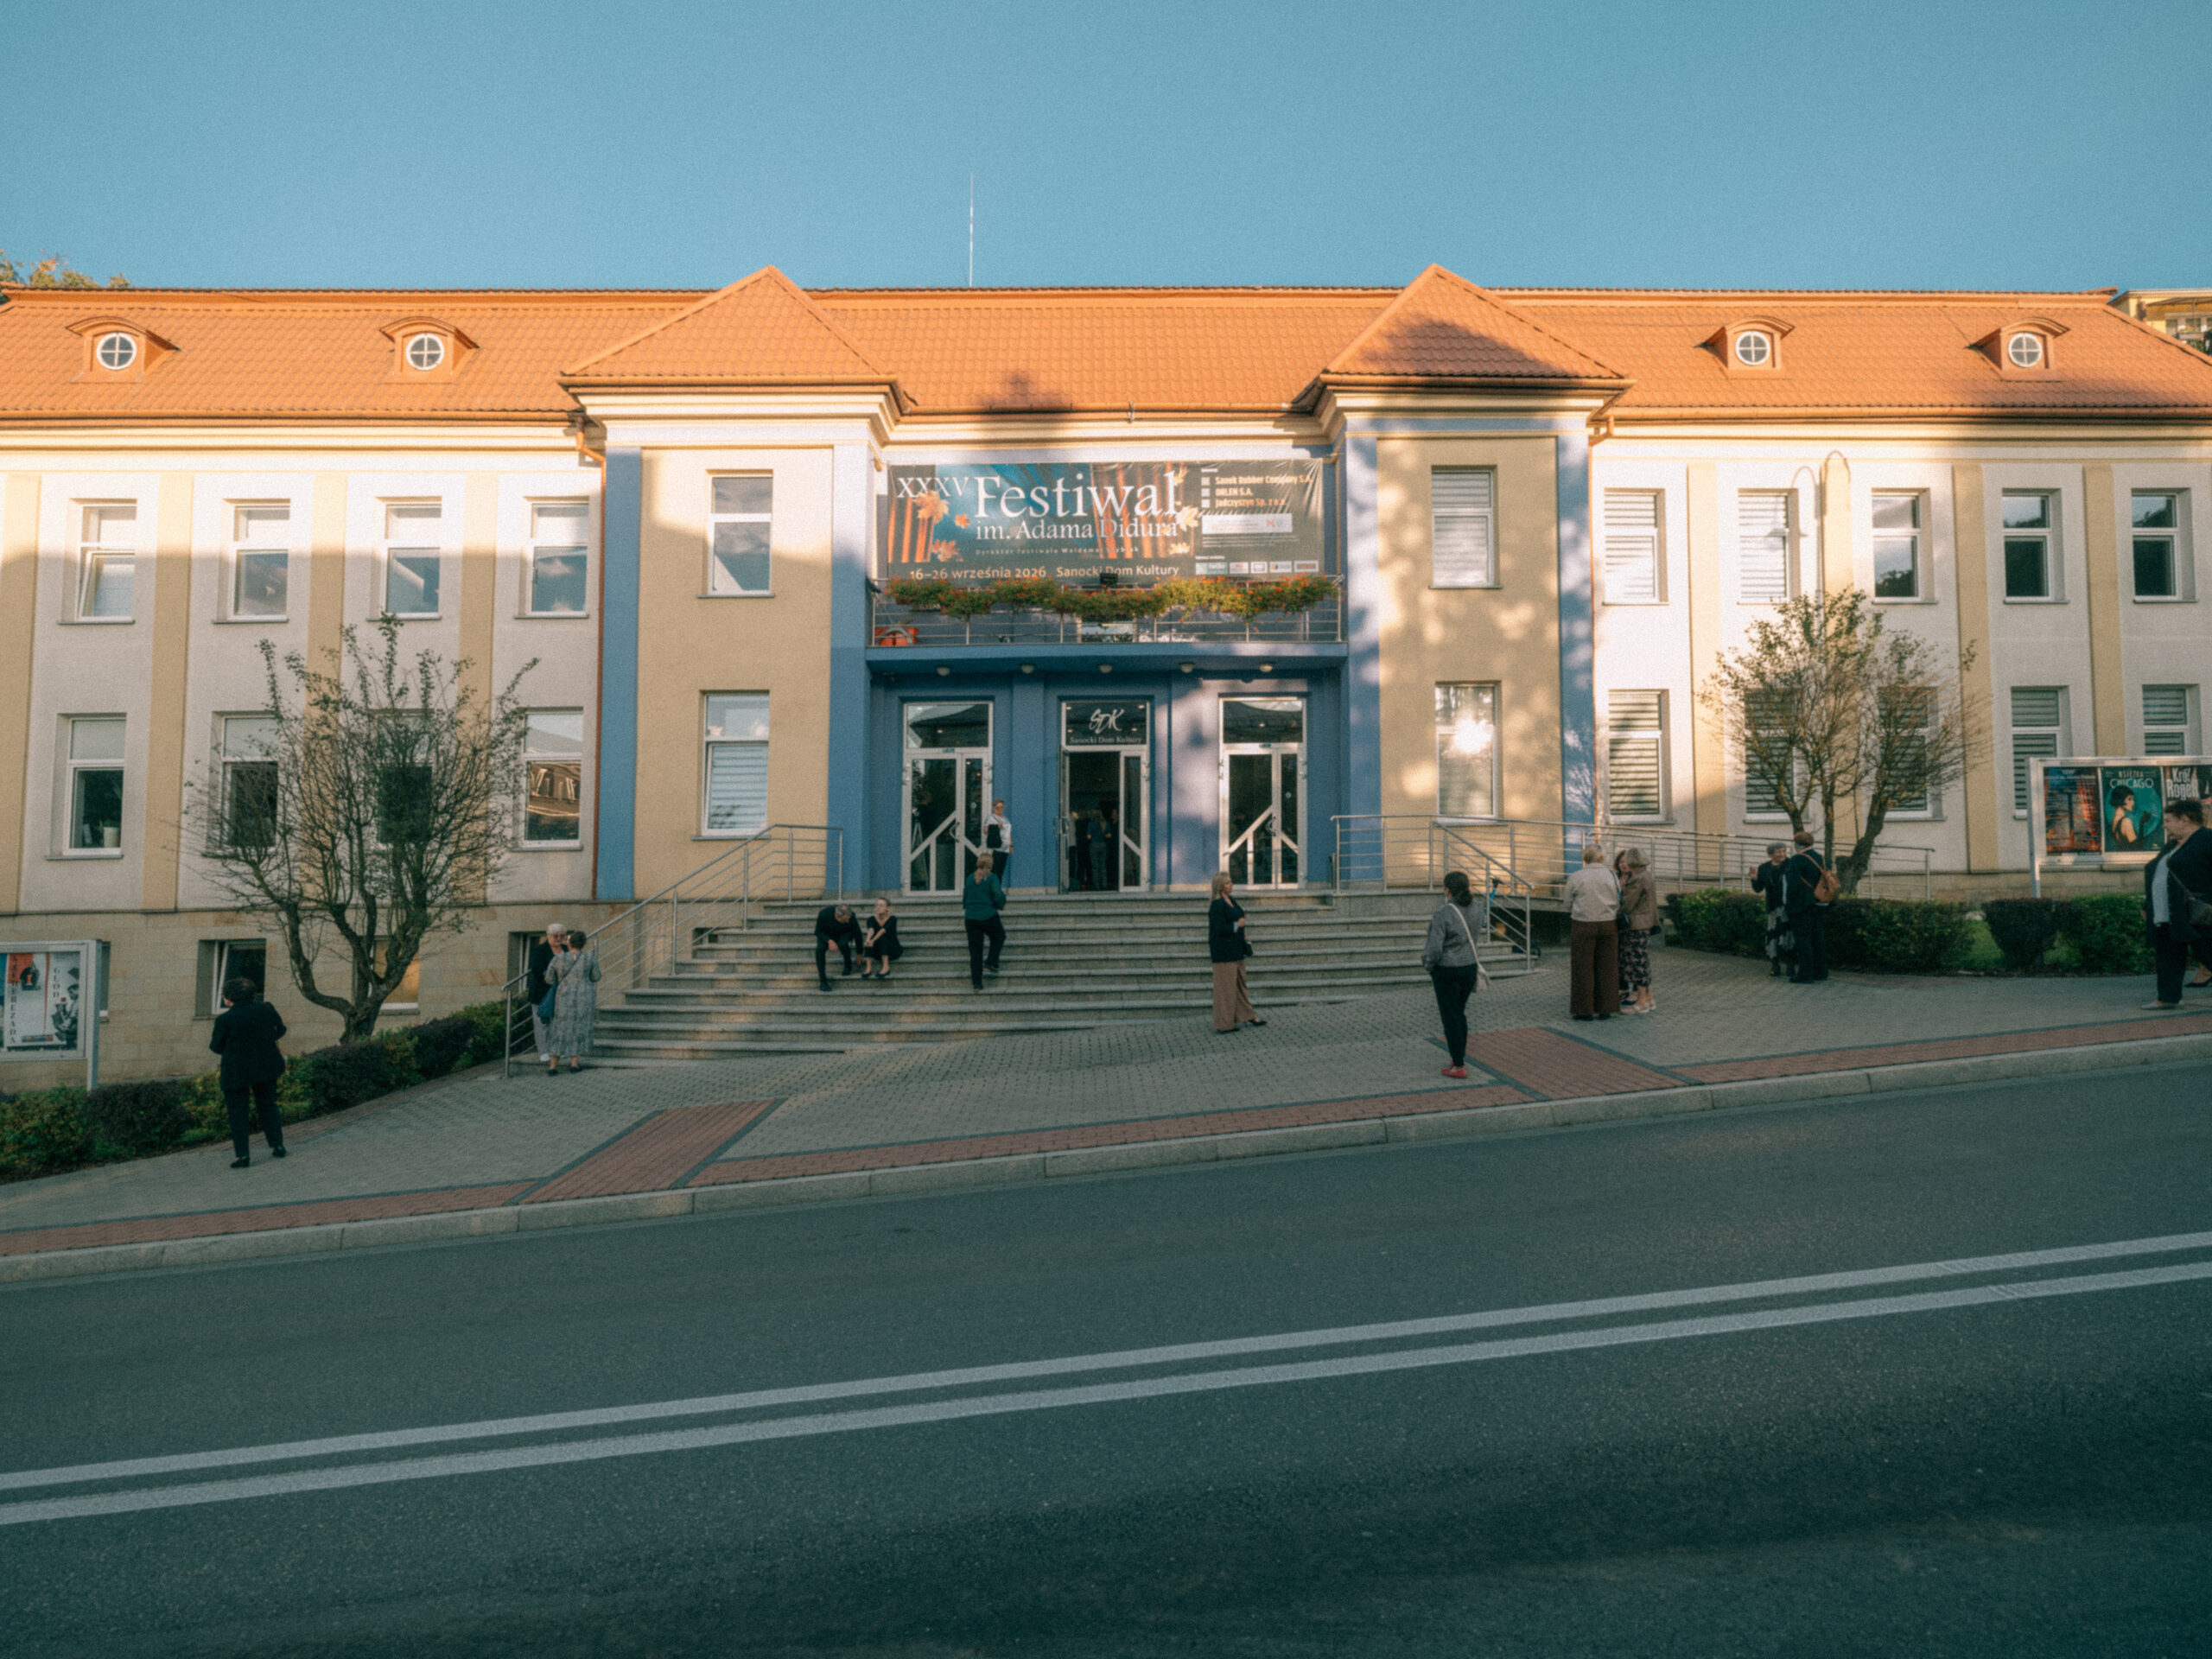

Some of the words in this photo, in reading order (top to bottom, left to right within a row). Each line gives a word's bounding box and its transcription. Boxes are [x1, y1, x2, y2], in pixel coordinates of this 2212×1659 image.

[897, 477, 969, 498] XXXV
[974, 470, 1178, 518] Festiwal
[1239, 487, 1253, 496] S.A.
[976, 520, 1010, 540] im.
[1016, 518, 1094, 539] Adama
[1099, 518, 1178, 537] Didura
[952, 567, 1010, 579] września
[1015, 566, 1046, 578] 2026
[1057, 566, 1102, 577] Sanocki
[1106, 566, 1133, 575] Dom
[1136, 565, 1179, 576] Kultury
[1089, 709, 1125, 734] SDK
[2109, 778, 2154, 789] CHICAGO
